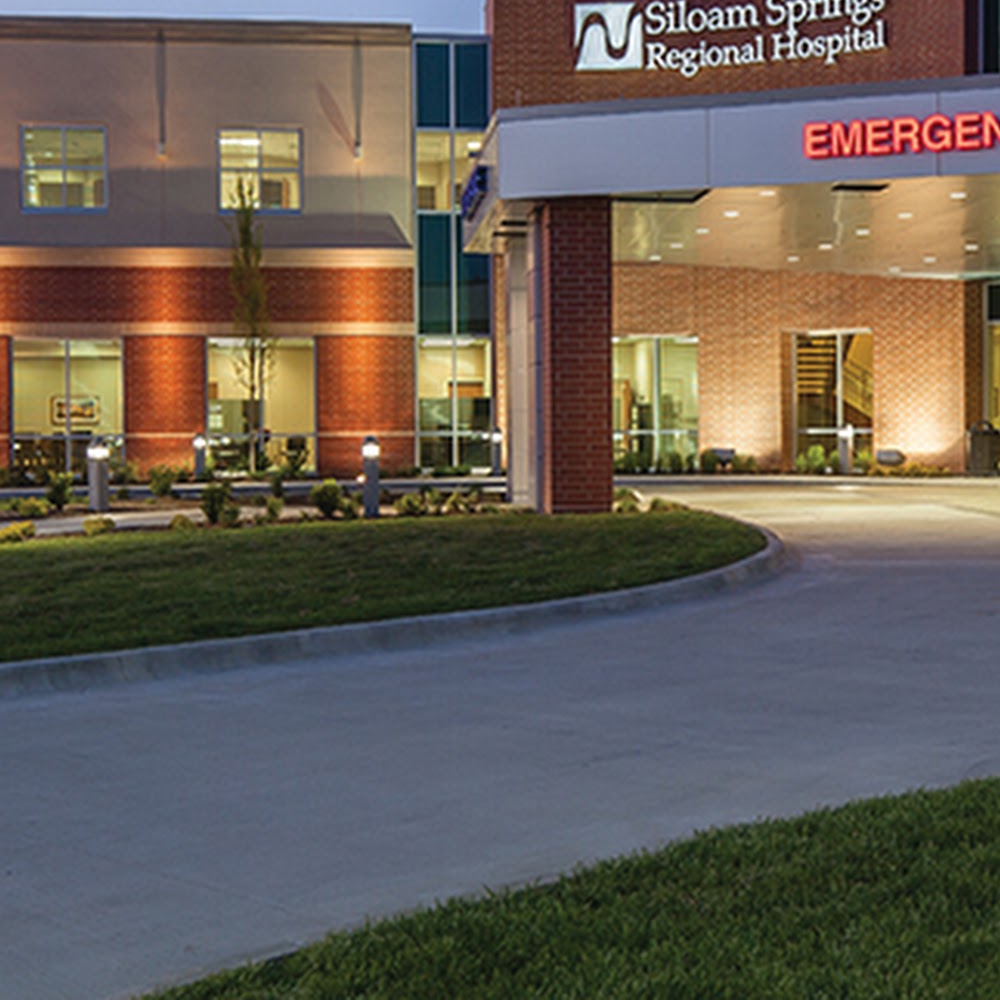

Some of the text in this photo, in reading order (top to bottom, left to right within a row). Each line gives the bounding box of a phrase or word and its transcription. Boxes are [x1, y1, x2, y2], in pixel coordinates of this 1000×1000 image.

[644, 0, 758, 35] Siloam
[645, 20, 885, 77] Regional Hospital
